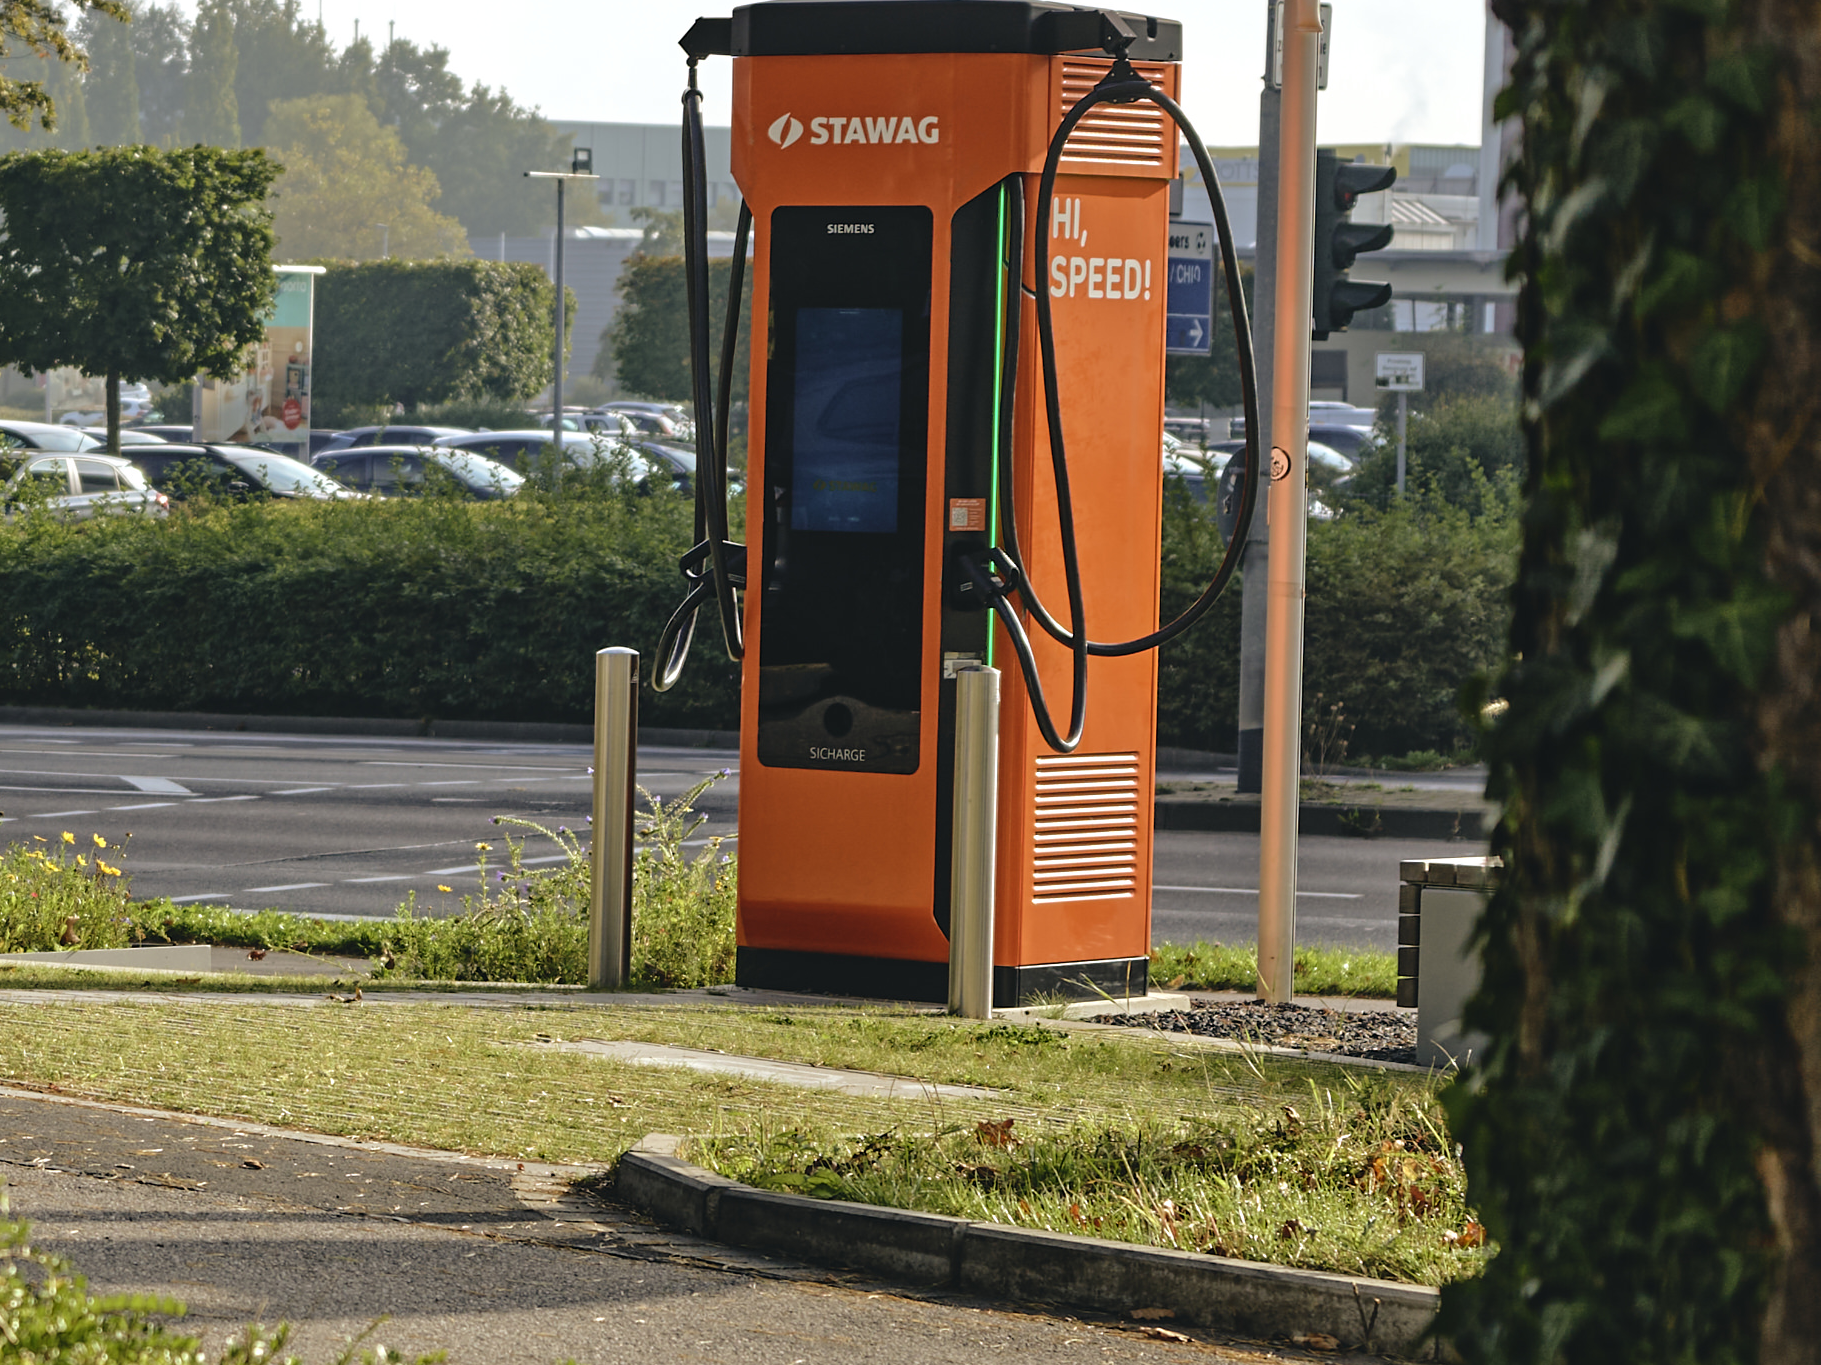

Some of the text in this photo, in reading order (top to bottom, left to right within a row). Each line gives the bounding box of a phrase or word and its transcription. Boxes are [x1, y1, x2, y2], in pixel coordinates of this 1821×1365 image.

[810, 116, 939, 145] STAWAG
[827, 224, 875, 234] SIEMENS
[1053, 197, 1087, 247] HI,
[1050, 255, 1151, 300] SPEED!
[809, 746, 866, 762] SICHARGE
